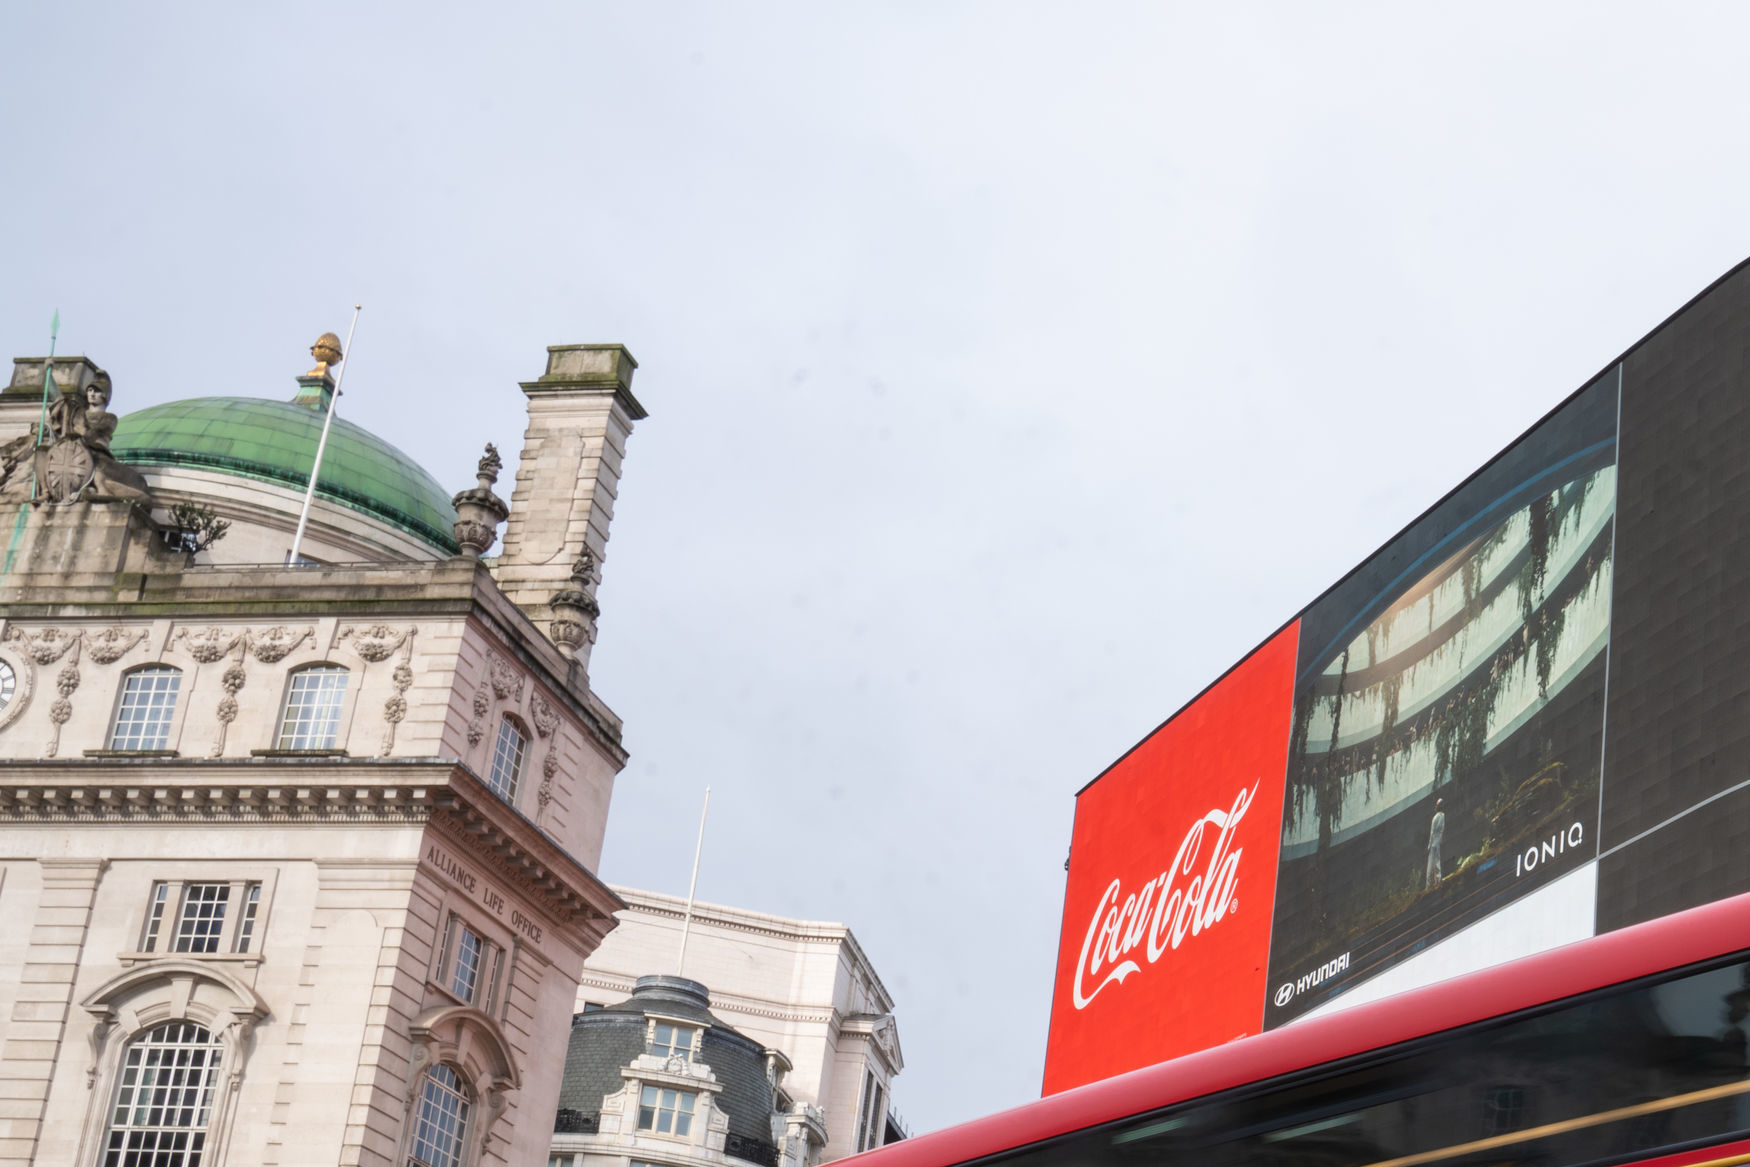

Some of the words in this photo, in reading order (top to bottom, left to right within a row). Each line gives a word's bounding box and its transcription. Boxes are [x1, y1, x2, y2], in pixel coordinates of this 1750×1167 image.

[1516, 822, 1583, 877] IONIQ
[427, 846, 476, 894] ALLIANCE
[483, 888, 504, 915] LIFE
[511, 910, 542, 944] OFFICE
[1073, 777, 1261, 1010] Coca-Cola
[1296, 952, 1350, 995] HYUNDAI
